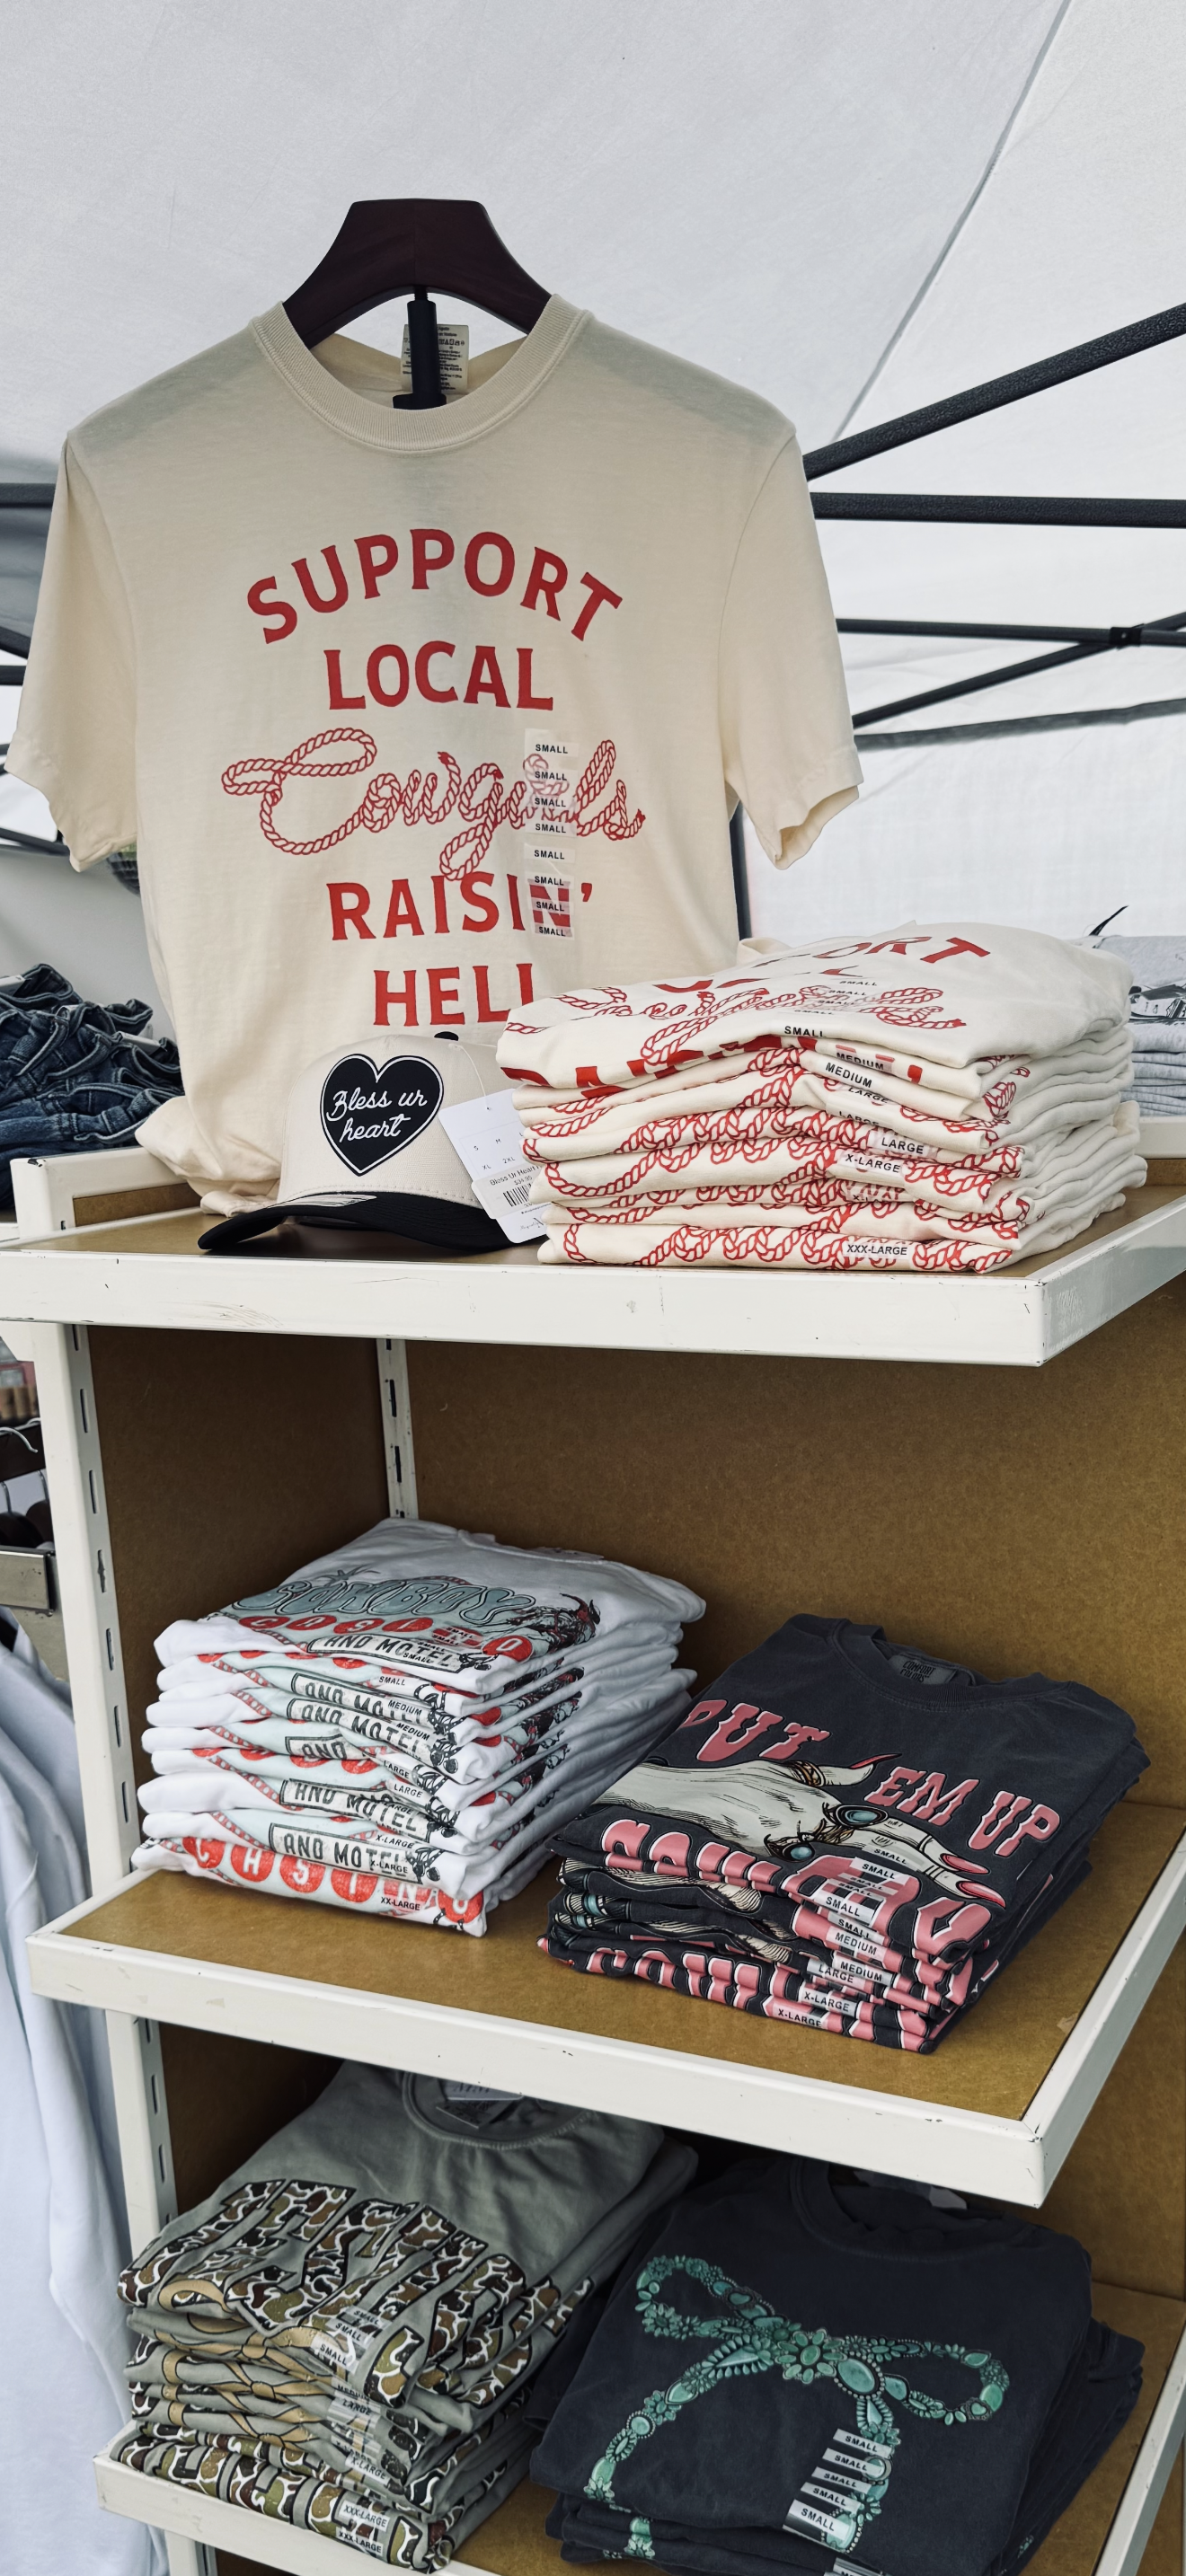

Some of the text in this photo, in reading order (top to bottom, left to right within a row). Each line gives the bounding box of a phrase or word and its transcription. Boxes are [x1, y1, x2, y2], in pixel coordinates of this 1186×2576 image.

[247, 528, 623, 644] SUPPORT
[323, 640, 553, 711] LOCAL
[535, 744, 569, 754] SMALL
[535, 771, 568, 781] SMALL
[222, 728, 646, 881] Cowgirls
[535, 798, 567, 807] SMALL
[535, 823, 567, 834] SMALL
[534, 850, 565, 860] SMALL
[535, 876, 564, 886] SMALL
[535, 901, 565, 912] SMALL
[538, 926, 566, 937] SMALL
[836, 1052, 884, 1070] MEDIUM
[825, 1062, 872, 1089] MEDIUM
[326, 1086, 428, 1122] Bless ur
[848, 1087, 889, 1104] LARGE
[339, 1113, 411, 1143] heart
[881, 1137, 925, 1154] LARGE
[502, 1156, 516, 1164] 2XL
[845, 1153, 901, 1173] X-LARGE
[517, 1167, 536, 1177] Heart
[846, 1244, 907, 1256] XXX-LARGE
[432, 1635, 459, 1645] SMALL
[447, 1628, 474, 1638] SMALL
[323, 1635, 373, 1650] AND
[376, 1638, 453, 1667] MOTEL
[417, 1641, 447, 1652] SMALL
[403, 1652, 434, 1664] SMALL
[903, 1660, 936, 1676] COMFORT
[379, 1676, 405, 1686] SMALL
[388, 1699, 422, 1716] MEDIUM
[396, 1723, 430, 1741] MEDIUM
[680, 1699, 831, 1762] PUT
[384, 1760, 410, 1778] LARGE
[394, 1783, 423, 1798] LARGE
[968, 1790, 1060, 1857] UP
[375, 1834, 415, 1849] X-LARGE
[283, 1833, 407, 1877] AND MOTEL
[873, 1848, 907, 1865] SMALL
[370, 1859, 408, 1874] X-LARGE
[862, 1863, 896, 1880] SMALL
[838, 1883, 872, 1897] SMALL
[850, 1876, 883, 1891] SMALL
[381, 1896, 420, 1911] XX-LARGE
[826, 1896, 860, 1917] SMALL
[838, 1919, 871, 1939] SMALL
[835, 1932, 877, 1956] MEDIUM
[819, 1963, 854, 1984] LARGE
[840, 1961, 883, 1981] MEDIUM
[804, 1991, 850, 2012] X-LARGE
[778, 2008, 822, 2027] X-LARGE
[354, 2310, 379, 2325] SMALL
[335, 2323, 361, 2341] SMALL
[320, 2343, 347, 2366] SMALL
[845, 2435, 878, 2452] SMALL
[351, 2457, 386, 2480] X-LARGE
[835, 2455, 867, 2472] SMALL
[824, 2473, 857, 2488] SMALL
[813, 2487, 846, 2507] SMALL
[343, 2505, 387, 2527] XXX-LARGE
[801, 2509, 835, 2532] SMALL
[339, 2531, 382, 2554] XXX-LARGE
